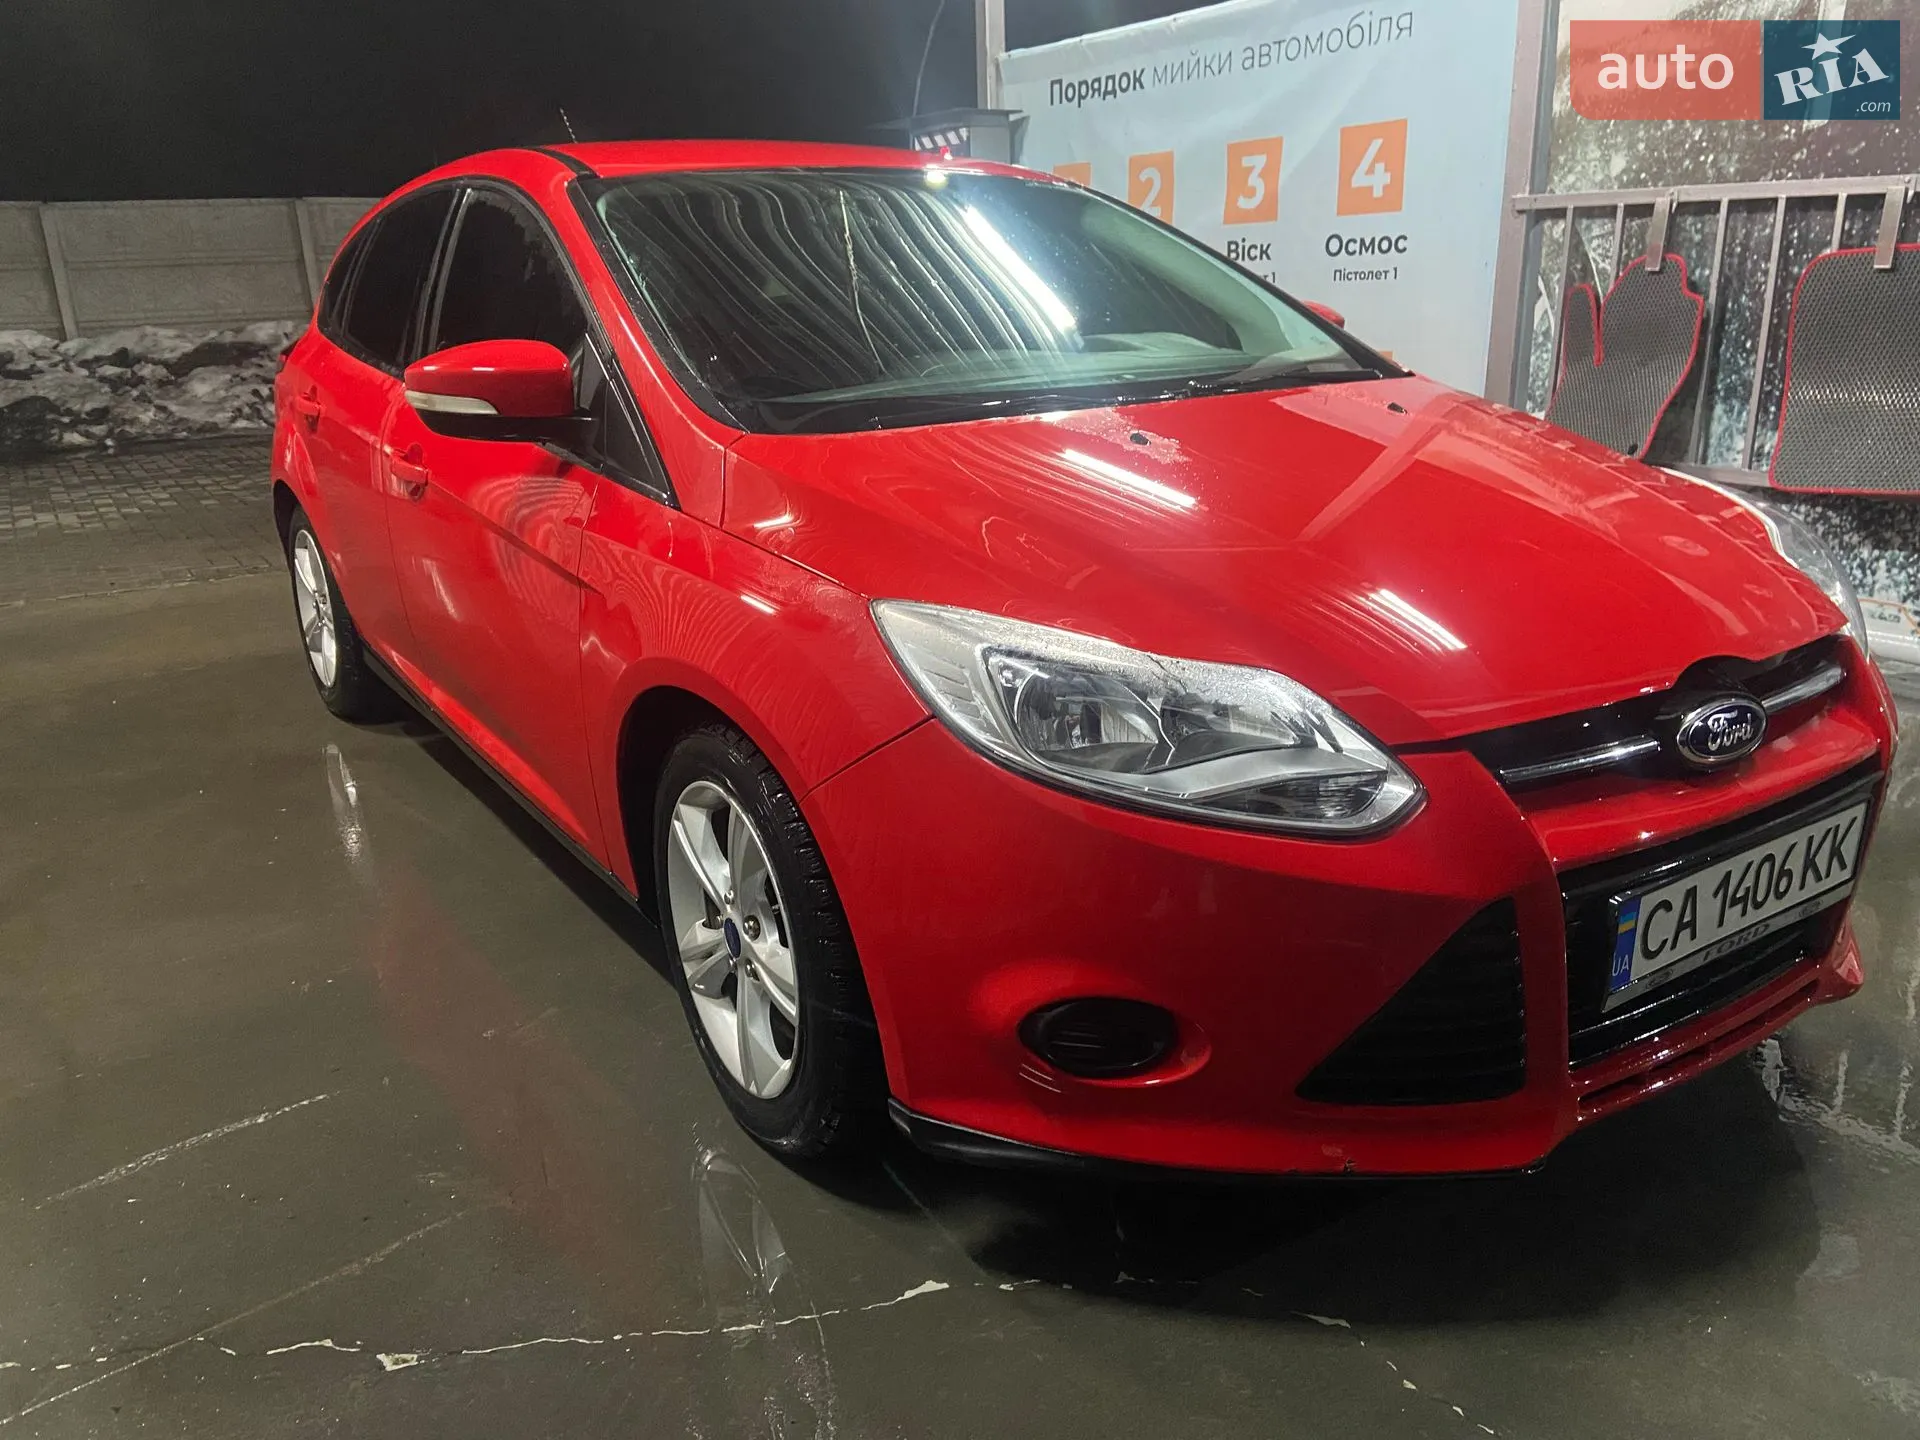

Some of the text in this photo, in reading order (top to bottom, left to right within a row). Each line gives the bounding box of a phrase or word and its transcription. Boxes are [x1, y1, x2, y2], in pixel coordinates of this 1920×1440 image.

[1049, 10, 1413, 109] Порядок мийки автомобіля
[1138, 137, 1392, 218] 2 3 4
[1226, 236, 1272, 262] Віск
[1324, 233, 1408, 258] Осмос
[1333, 266, 1398, 282] Пістолет 1
[1706, 708, 1755, 752] Ford
[1641, 816, 1858, 960] CA 1406 KK
[1612, 952, 1630, 977] UA
